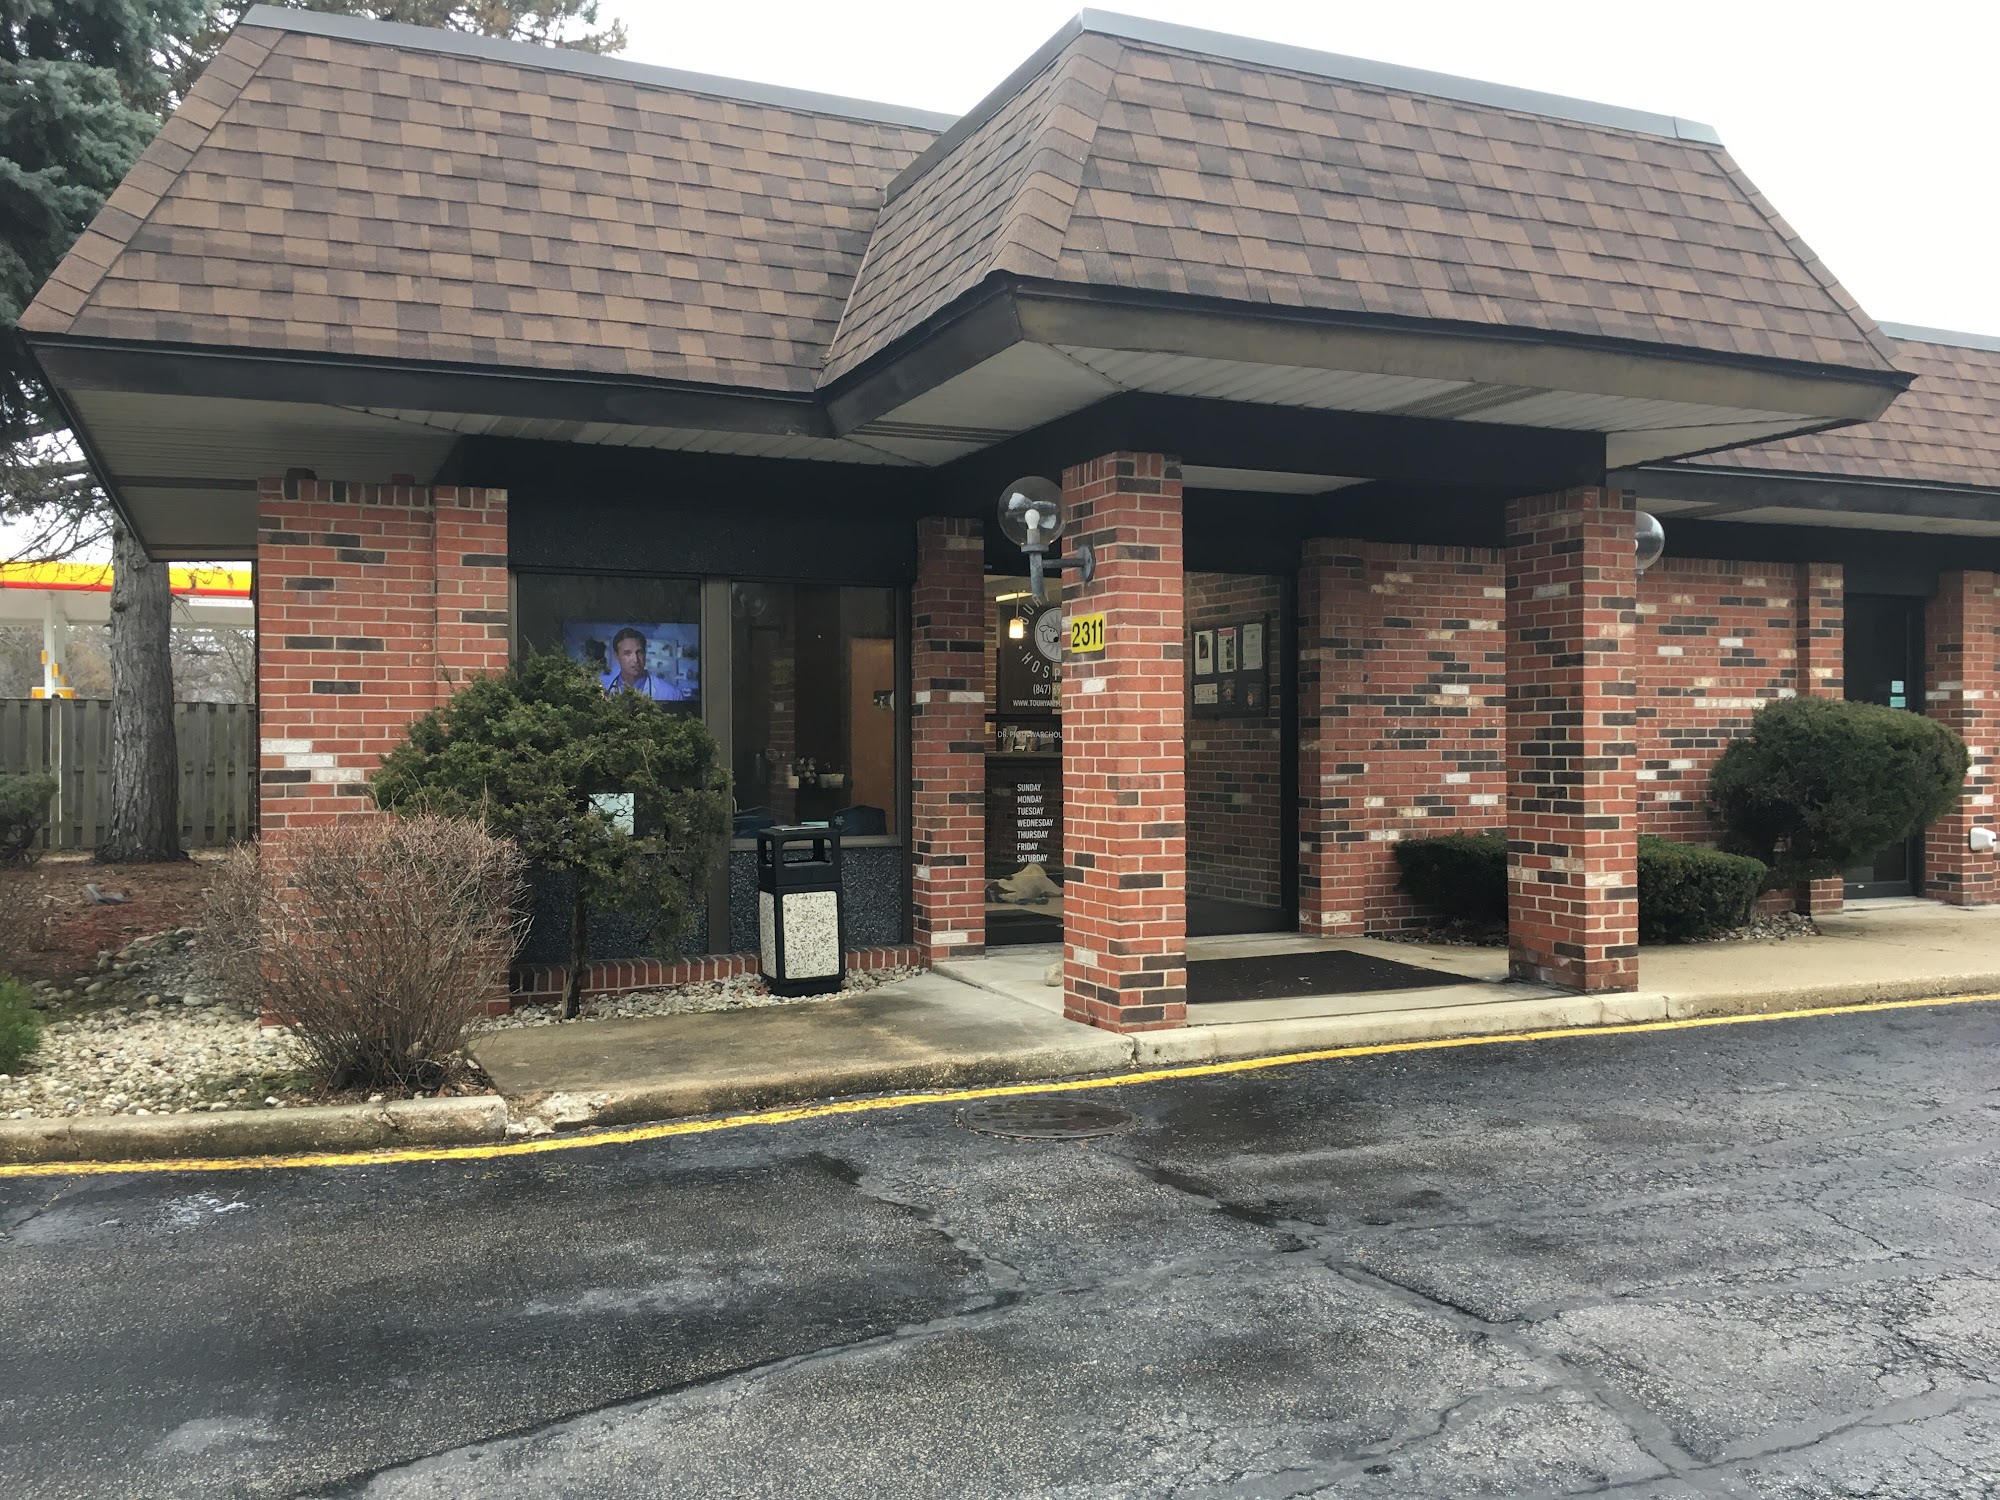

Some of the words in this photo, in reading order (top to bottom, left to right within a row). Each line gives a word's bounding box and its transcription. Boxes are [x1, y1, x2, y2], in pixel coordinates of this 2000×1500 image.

[1072, 618, 1103, 648] 2311
[1021, 651, 1061, 681] HOSP
[1032, 683, 1051, 695] (847)
[1012, 699, 1062, 707] WWW.TOUHYANIM
[997, 730, 1009, 738] DR.
[1031, 730, 1062, 739] WARCHOL
[1016, 783, 1041, 792] SUNDAY
[1016, 795, 1042, 804] MONDAY
[1016, 807, 1044, 815] TUESDAY
[1016, 819, 1054, 827] WEDNESDAY
[1016, 830, 1049, 839] THURSDAY
[1016, 842, 1038, 851] FRIDAY
[1016, 854, 1048, 863] SATURDAY
